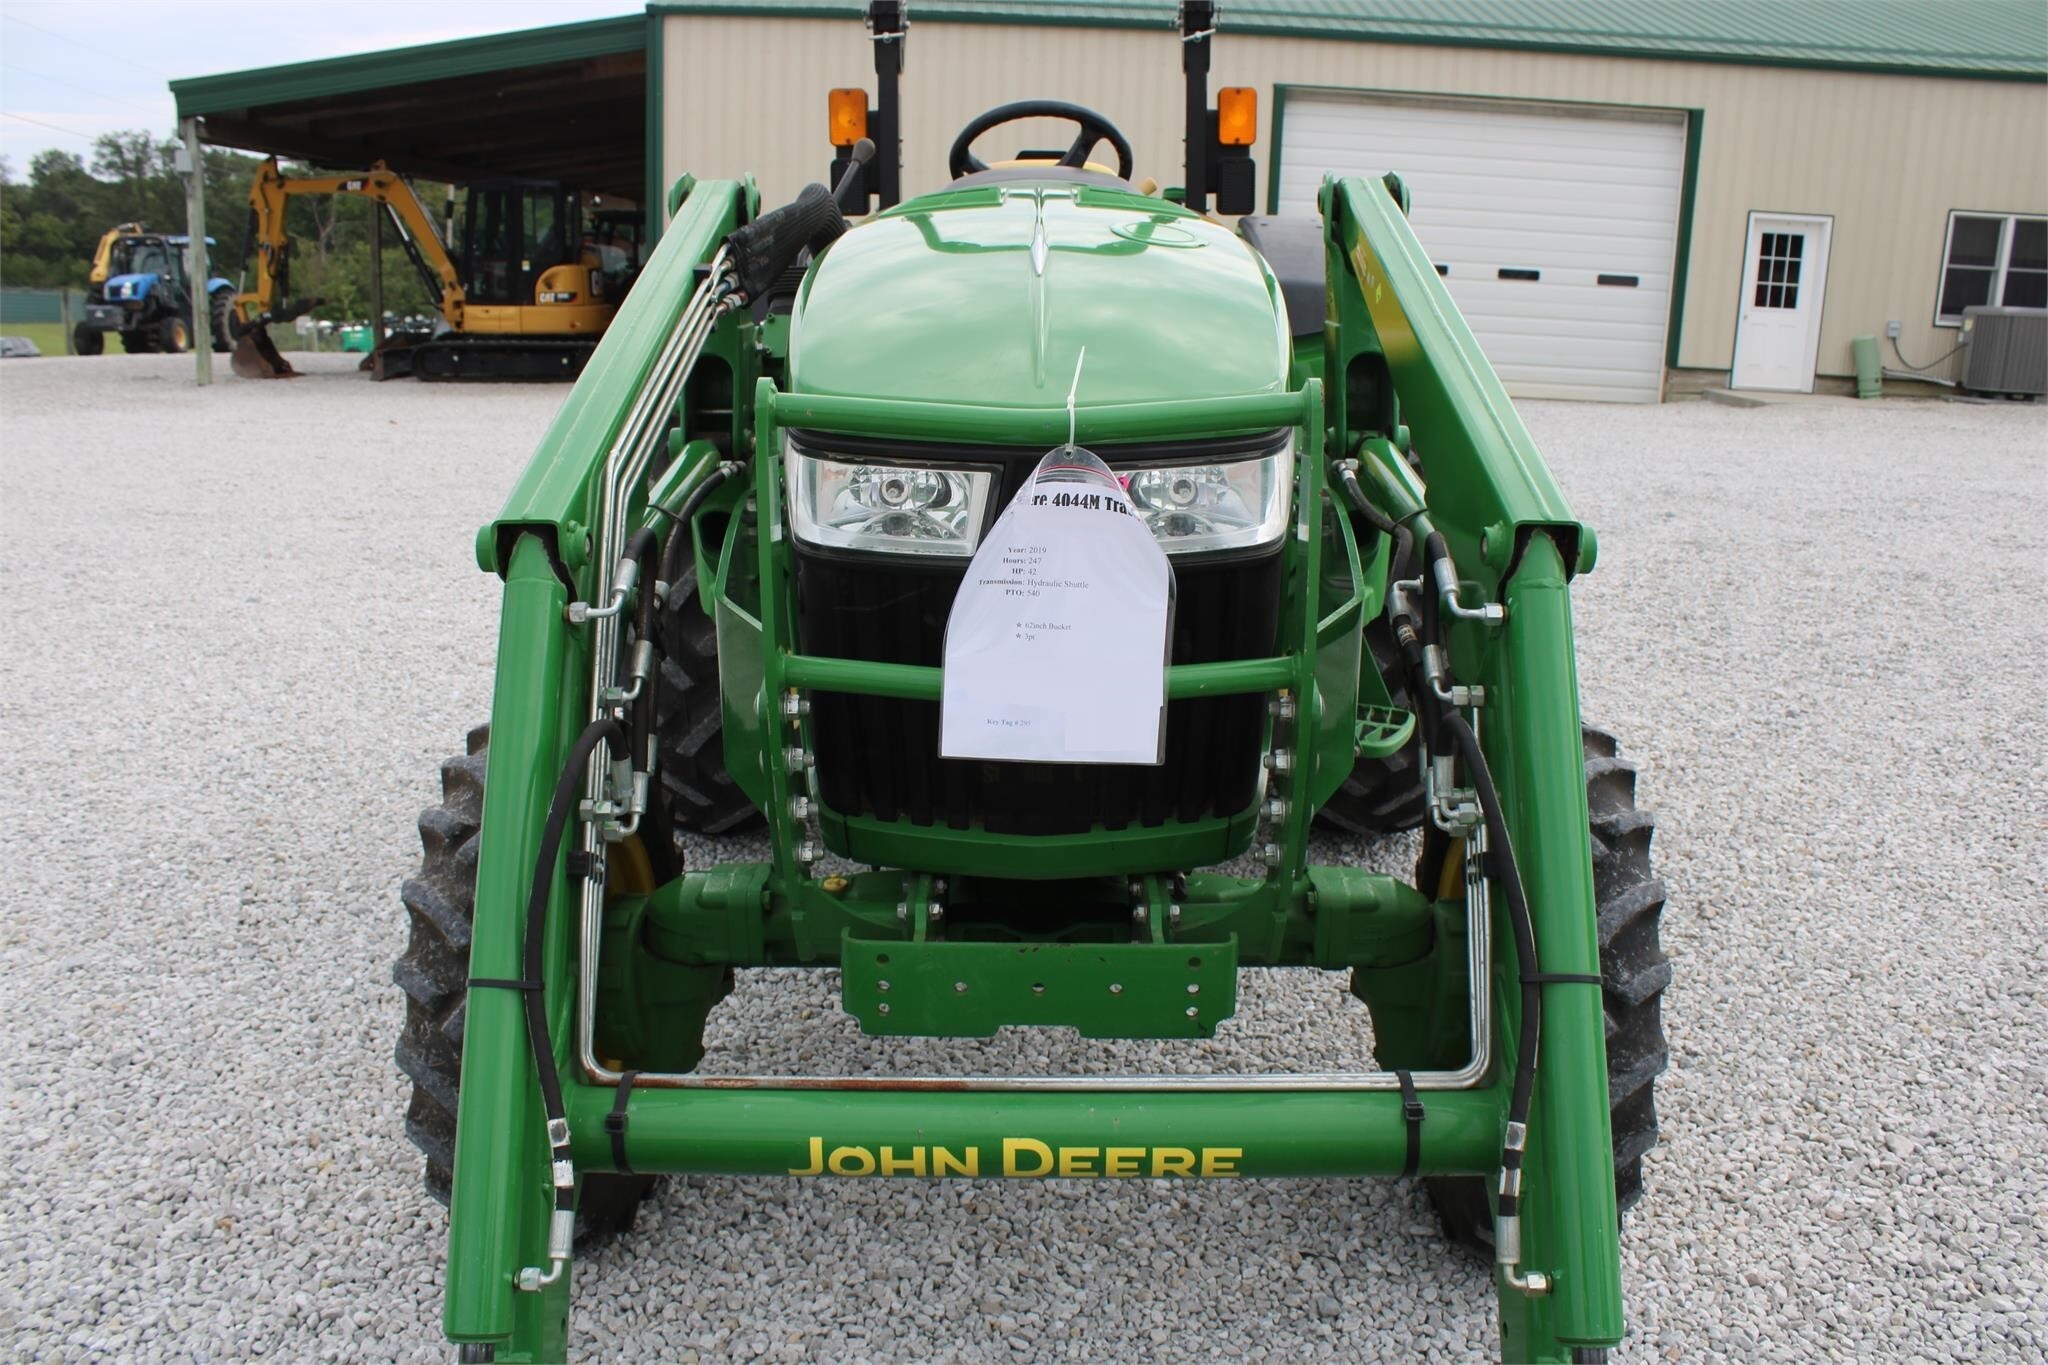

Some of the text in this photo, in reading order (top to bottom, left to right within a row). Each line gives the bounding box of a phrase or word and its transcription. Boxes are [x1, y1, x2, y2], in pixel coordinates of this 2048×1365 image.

[1052, 492, 1100, 510] 4044M
[1104, 496, 1133, 517] Tra
[1008, 546, 1047, 554] Year: 2019
[1002, 557, 1042, 565] Hours: 247
[1011, 567, 1037, 575] HP: 42
[978, 578, 1089, 589] Transmission: Hydraulic Shuttle
[1005, 589, 1025, 597] PTO:
[788, 1136, 1243, 1178] JOHN DEERE
